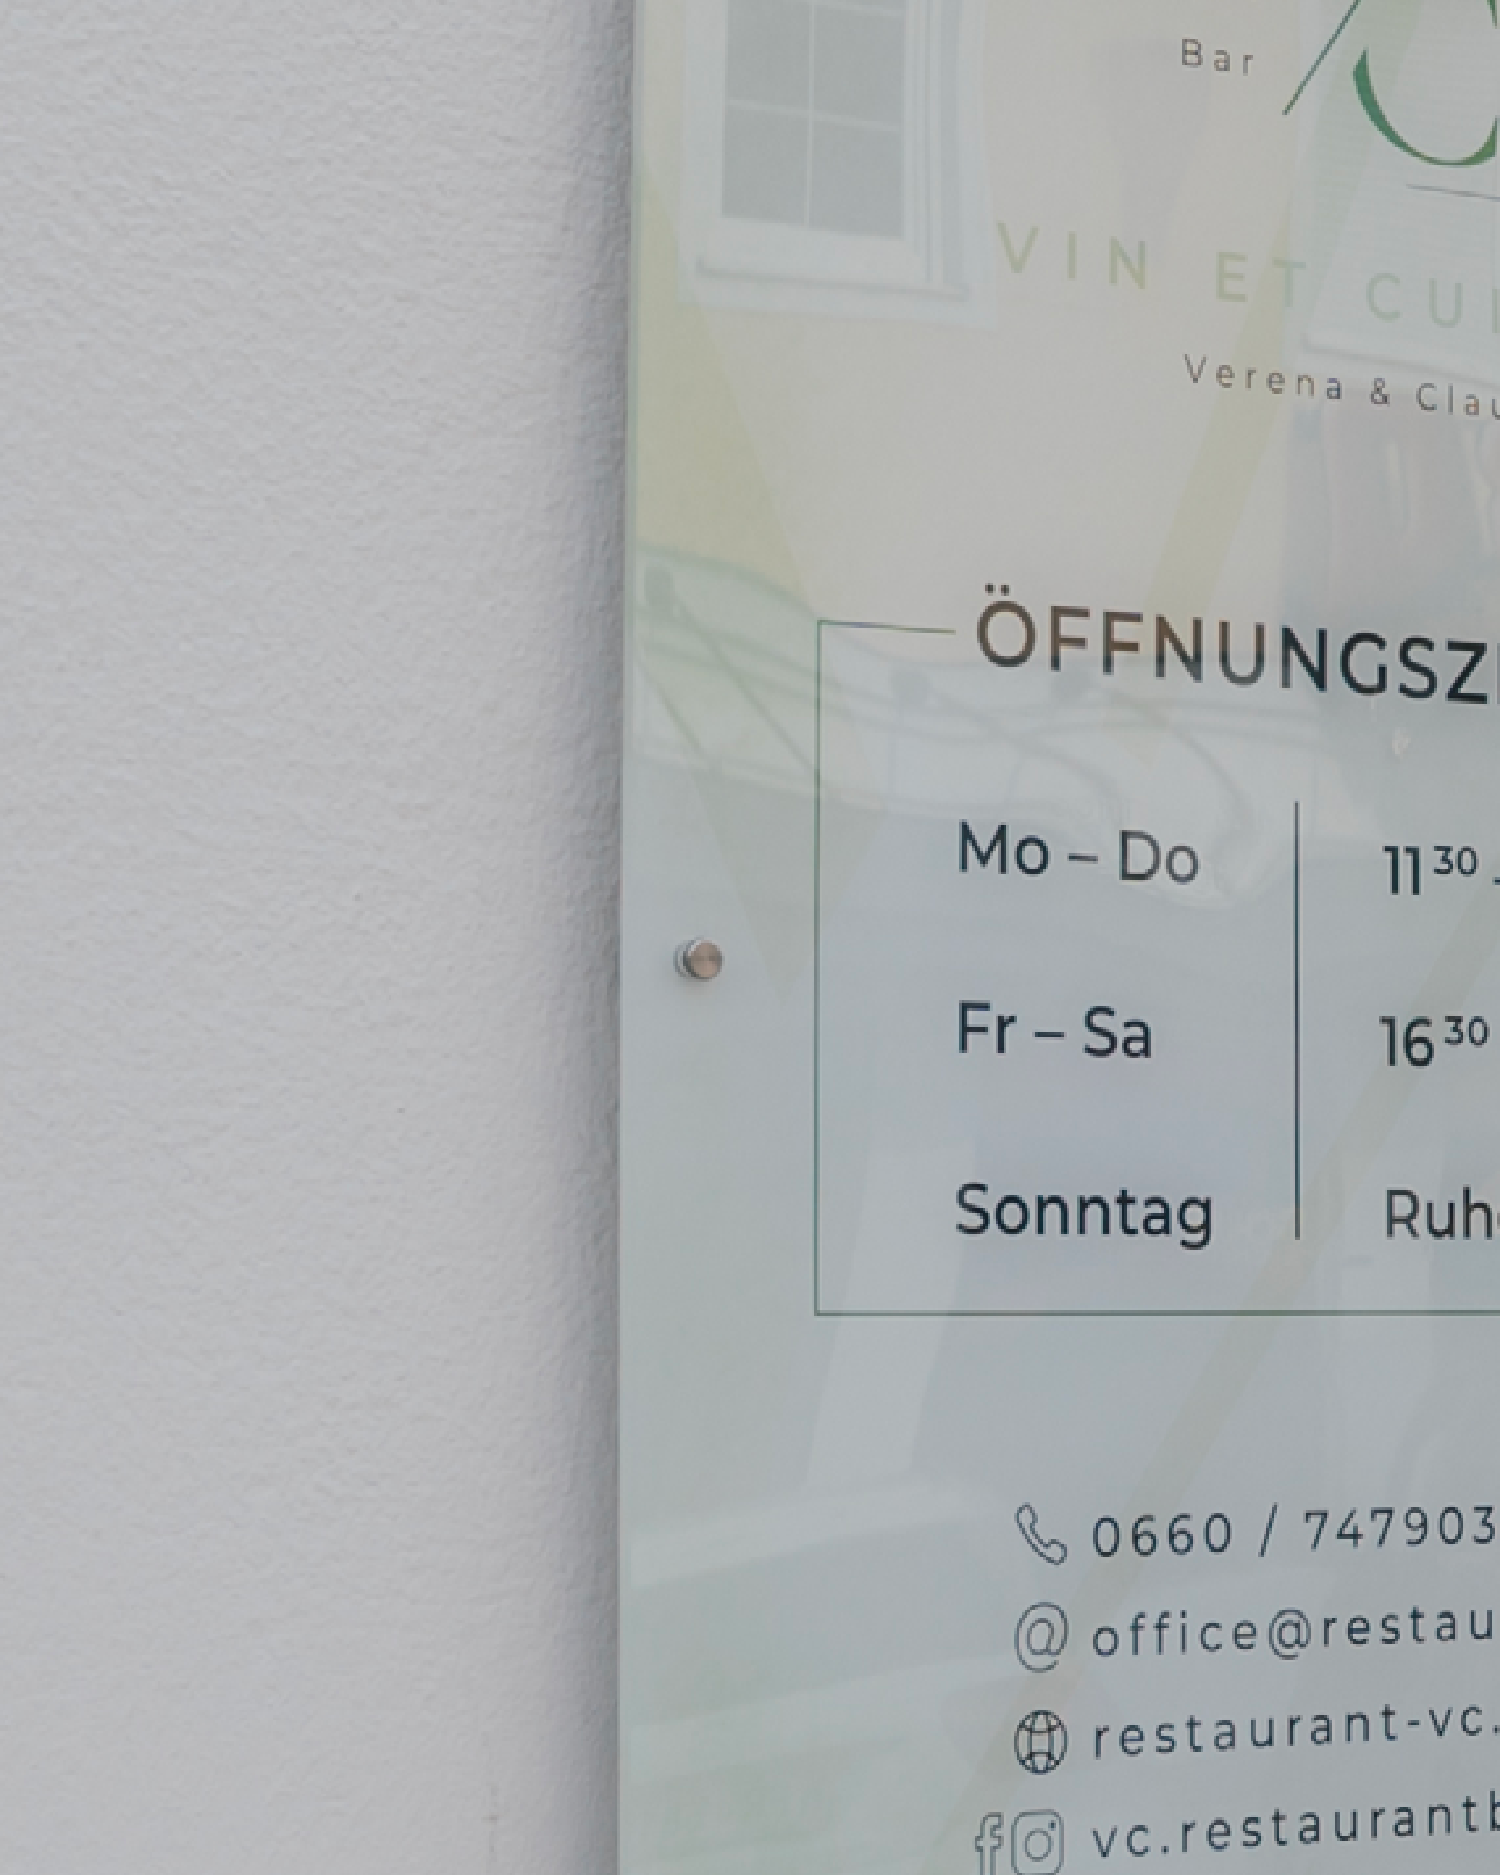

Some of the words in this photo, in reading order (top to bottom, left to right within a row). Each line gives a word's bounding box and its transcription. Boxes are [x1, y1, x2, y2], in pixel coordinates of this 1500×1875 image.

[1181, 37, 1254, 75] Bar
[996, 222, 1148, 291] VIN
[1215, 251, 1306, 308] ET
[1183, 353, 1343, 401] Verena
[1369, 377, 1390, 405] &
[959, 820, 1050, 876] Mo
[1119, 829, 1199, 884] Do
[958, 1000, 1018, 1054] Fr
[1083, 1005, 1152, 1059] Sa
[955, 1182, 1212, 1251] Sonntag
[1092, 1512, 1232, 1558] 0660
[1258, 1502, 1279, 1558] /
